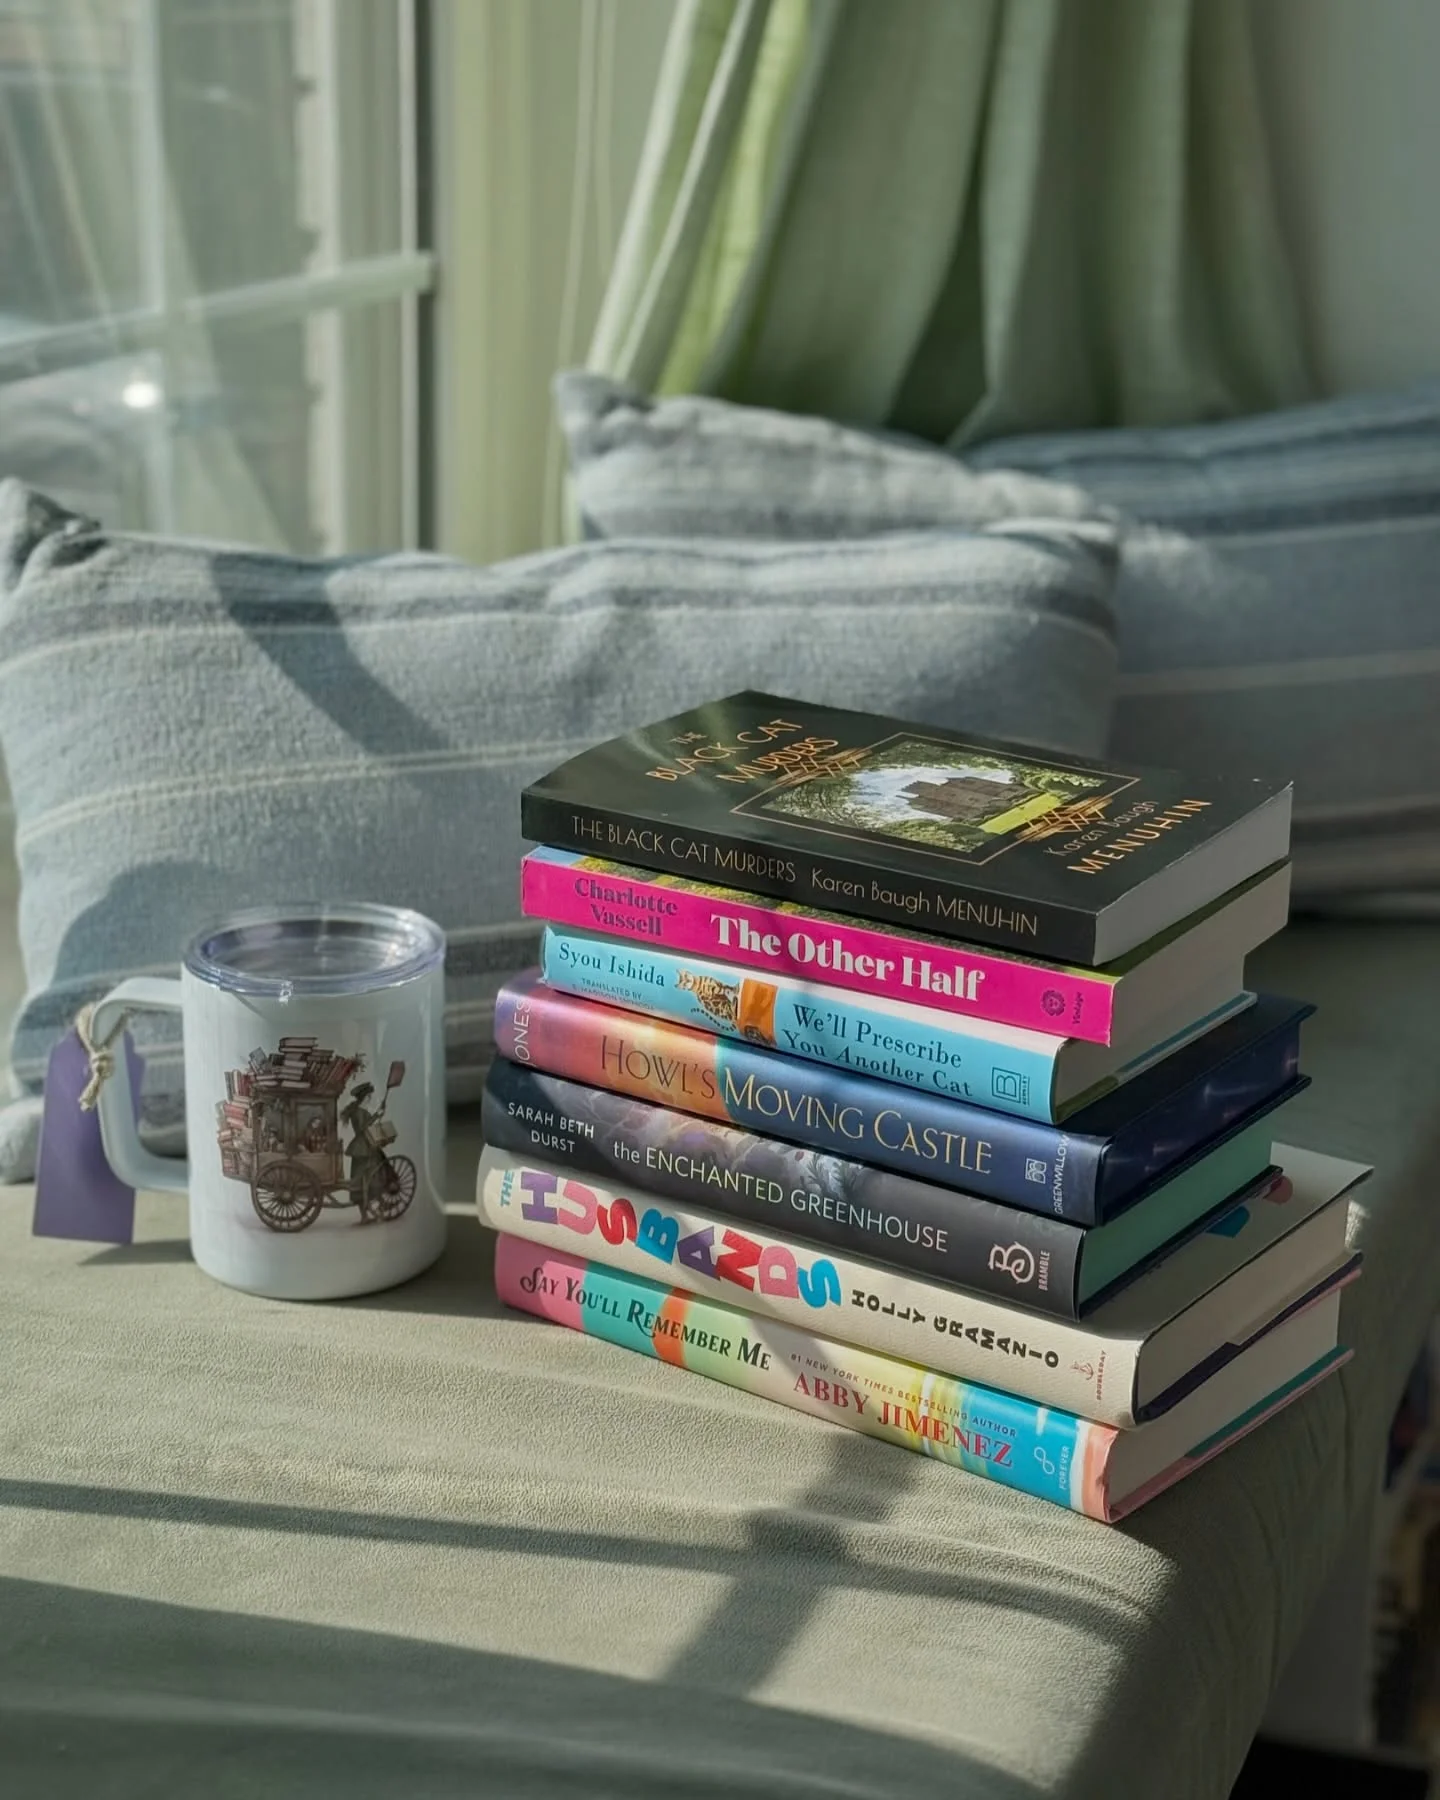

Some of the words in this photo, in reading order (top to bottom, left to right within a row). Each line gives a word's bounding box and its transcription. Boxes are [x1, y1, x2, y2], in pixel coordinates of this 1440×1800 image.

[646, 742, 748, 782] BLACK
[737, 718, 802, 744] CAT
[716, 737, 838, 783] MURDERS
[1043, 829, 1108, 857] Karen
[1097, 800, 1160, 827] Baugh
[1067, 799, 1212, 875] MENUHIN
[572, 816, 603, 841] THE
[608, 823, 664, 854] BLACK
[671, 838, 708, 864] CAT
[715, 846, 796, 882] MURDERS
[812, 867, 865, 898] Karen
[871, 880, 930, 914] Baugh
[937, 895, 1037, 936] MENUHIN
[575, 877, 678, 917] Charlotte
[591, 903, 662, 936] Vassell
[559, 943, 600, 969] Syou
[609, 956, 665, 987] Ishida
[582, 978, 630, 997] TRANSLATED
[710, 914, 781, 956] The
[788, 933, 895, 981] Other
[902, 956, 985, 1001] Half
[782, 1029, 826, 1058] You
[836, 1046, 925, 1082] Another
[932, 1071, 973, 1097] Cat
[793, 1004, 846, 1038] We'll
[856, 1020, 962, 1069] Prescribe
[508, 1102, 553, 1127] SARAH
[559, 1116, 595, 1139] BETH
[601, 1035, 715, 1099] HOWL'S
[724, 1067, 864, 1139] MOVING
[874, 1110, 992, 1175] CASTLE
[531, 1130, 576, 1153] DURST
[1052, 1134, 1071, 1214] GREENWILLOW
[499, 1169, 514, 1207] THE
[613, 1141, 640, 1164] the
[646, 1147, 783, 1204] ENCHANTED
[790, 1189, 949, 1253] GREENHOUSE
[520, 1170, 841, 1309] HUSBANDS
[1038, 1250, 1051, 1291] BRAMBLE
[520, 1267, 559, 1295] SAY
[564, 1277, 620, 1319] YOU'LL
[626, 1299, 731, 1357] REMEMBER
[737, 1336, 772, 1371] ME
[851, 1288, 926, 1324] HOLLY
[933, 1315, 1059, 1369] GRAMAZIO
[793, 1372, 869, 1416] ABBY
[877, 1402, 1013, 1468] JIMENEZ
[805, 1358, 828, 1372] NEW
[833, 1367, 859, 1382] YORK
[864, 1378, 894, 1394] TIMES
[898, 1390, 968, 1420] BESTSELLING
[972, 1417, 1017, 1438] AUTHOR
[1059, 1445, 1070, 1491] FOREVER
